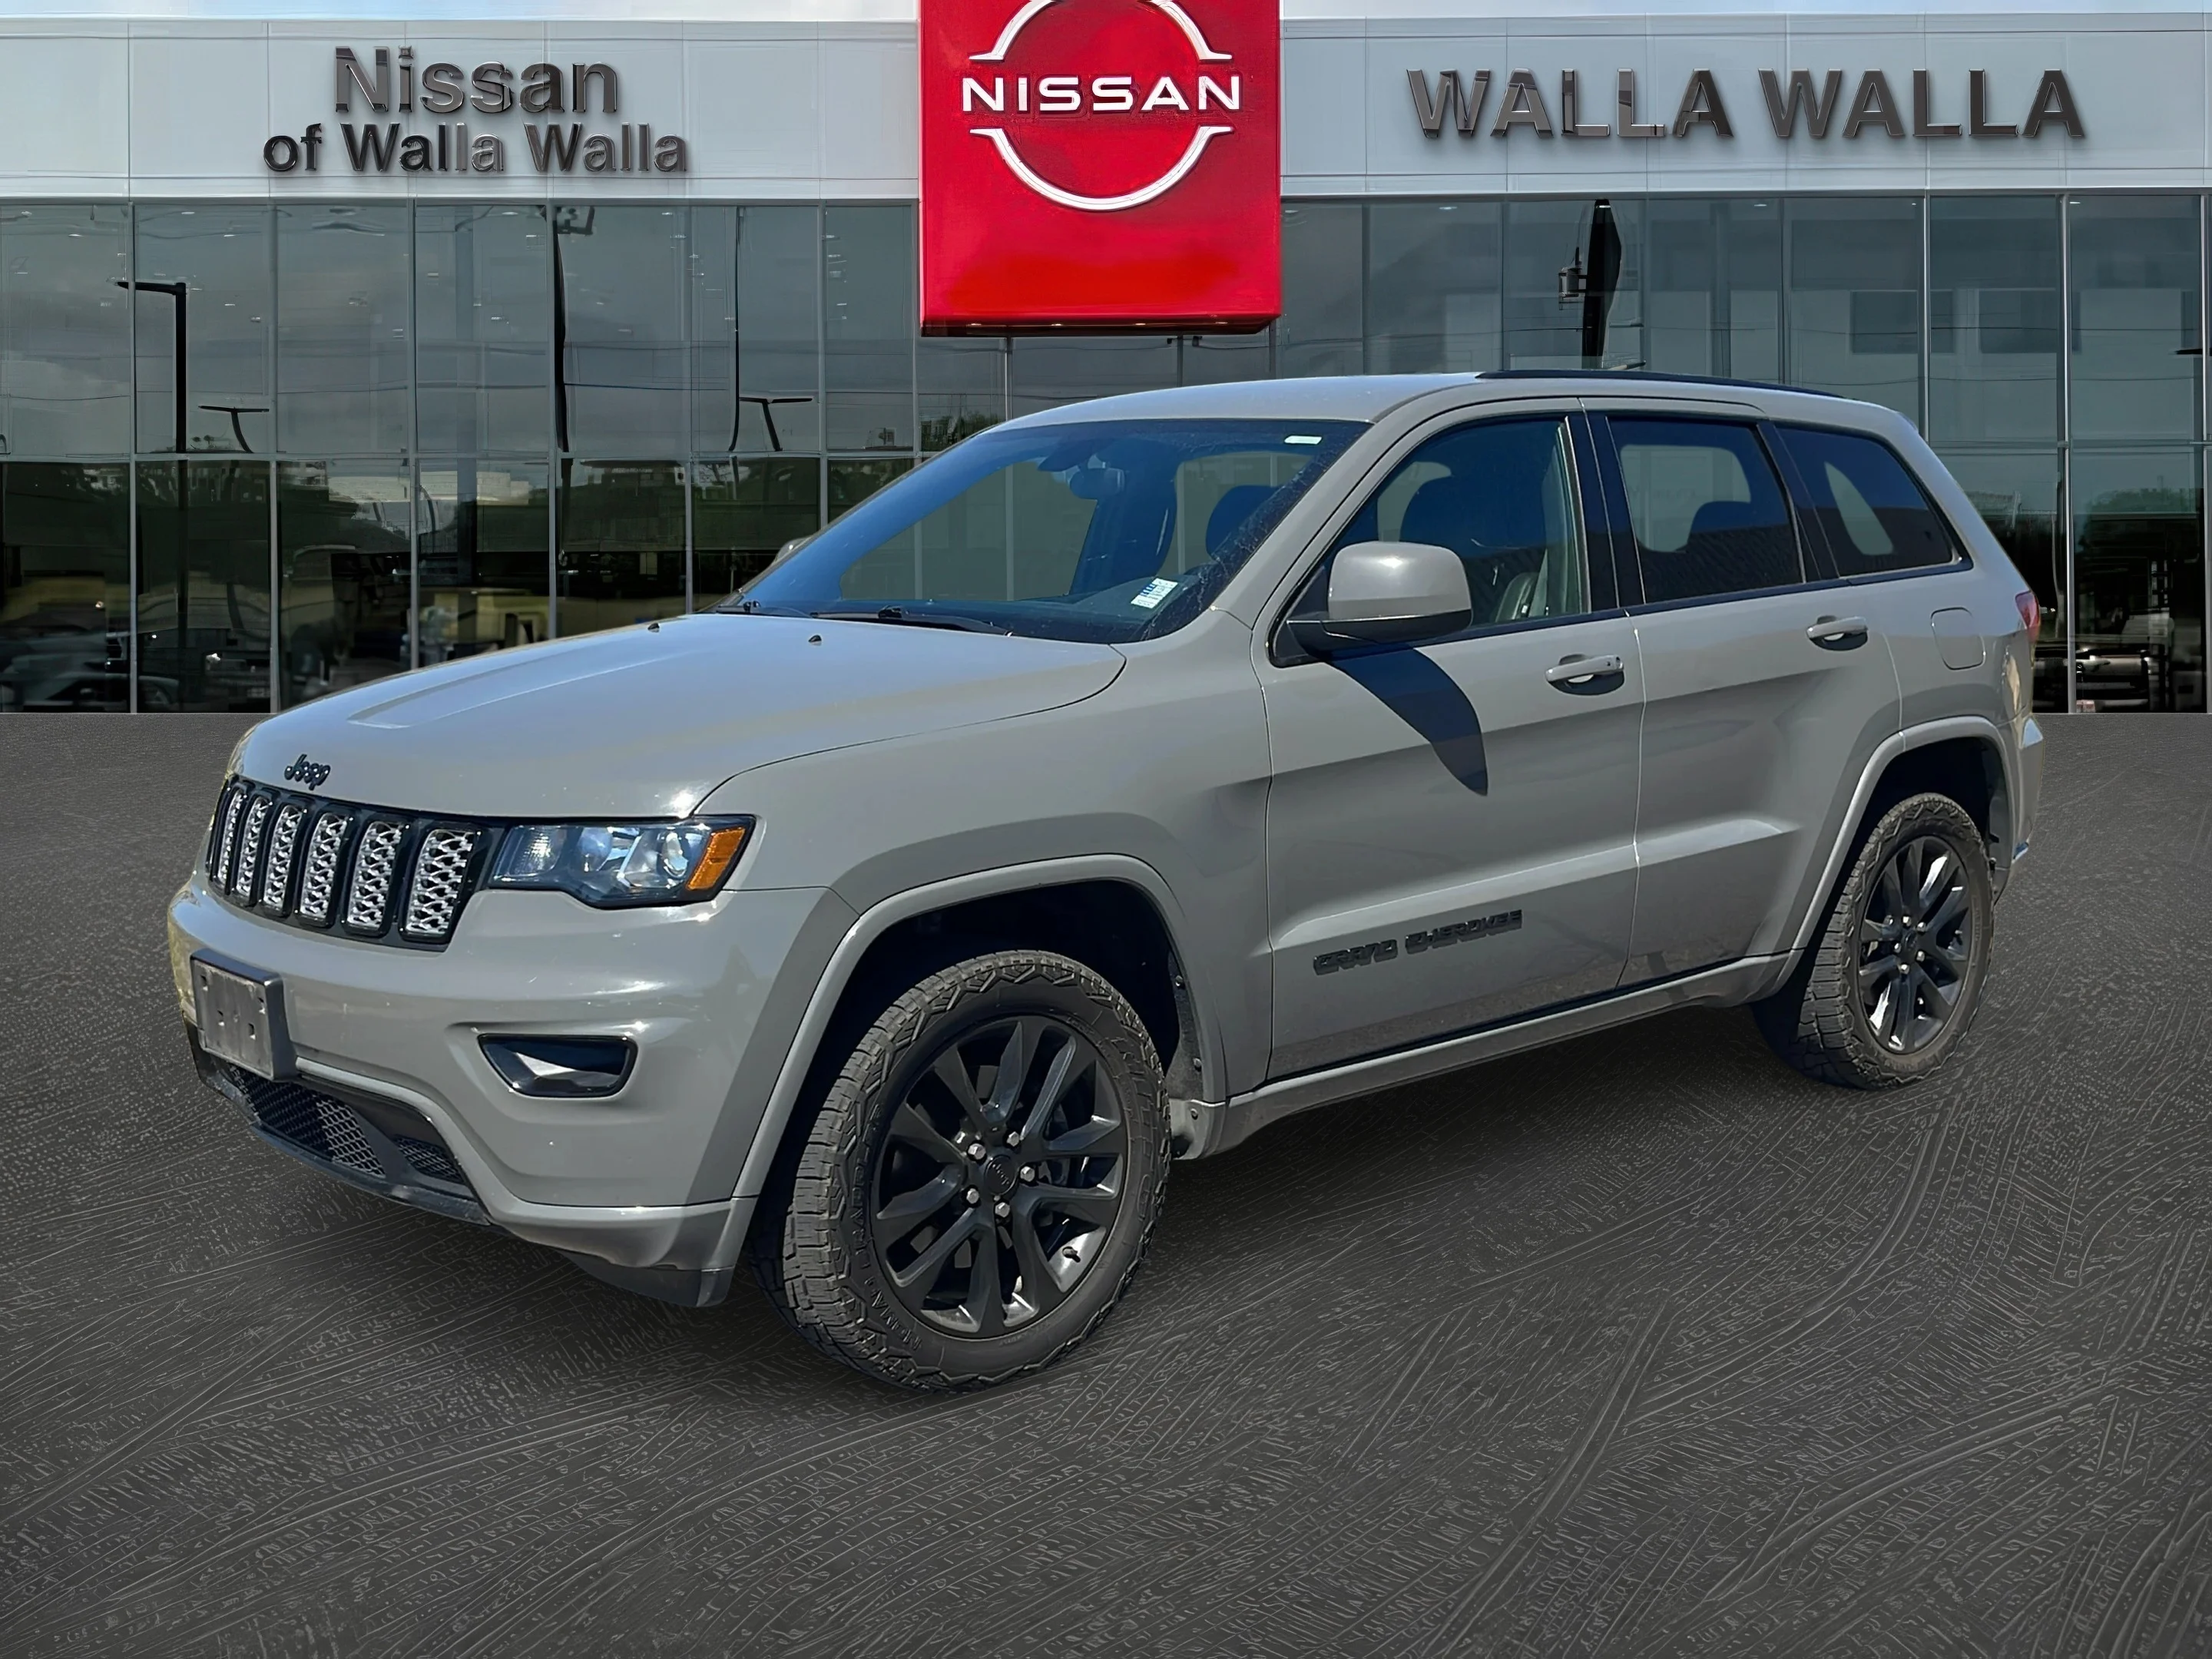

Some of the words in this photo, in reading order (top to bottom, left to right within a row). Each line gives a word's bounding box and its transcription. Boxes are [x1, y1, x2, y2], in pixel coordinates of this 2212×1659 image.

[334, 45, 618, 114] Nissan
[962, 75, 1240, 112] NISSAN
[1406, 68, 1734, 139] WALLA
[1757, 68, 2085, 139] WALLA
[263, 122, 323, 172] of
[340, 121, 505, 172] Walla
[523, 121, 687, 172] Walla
[284, 753, 331, 791] Jeep
